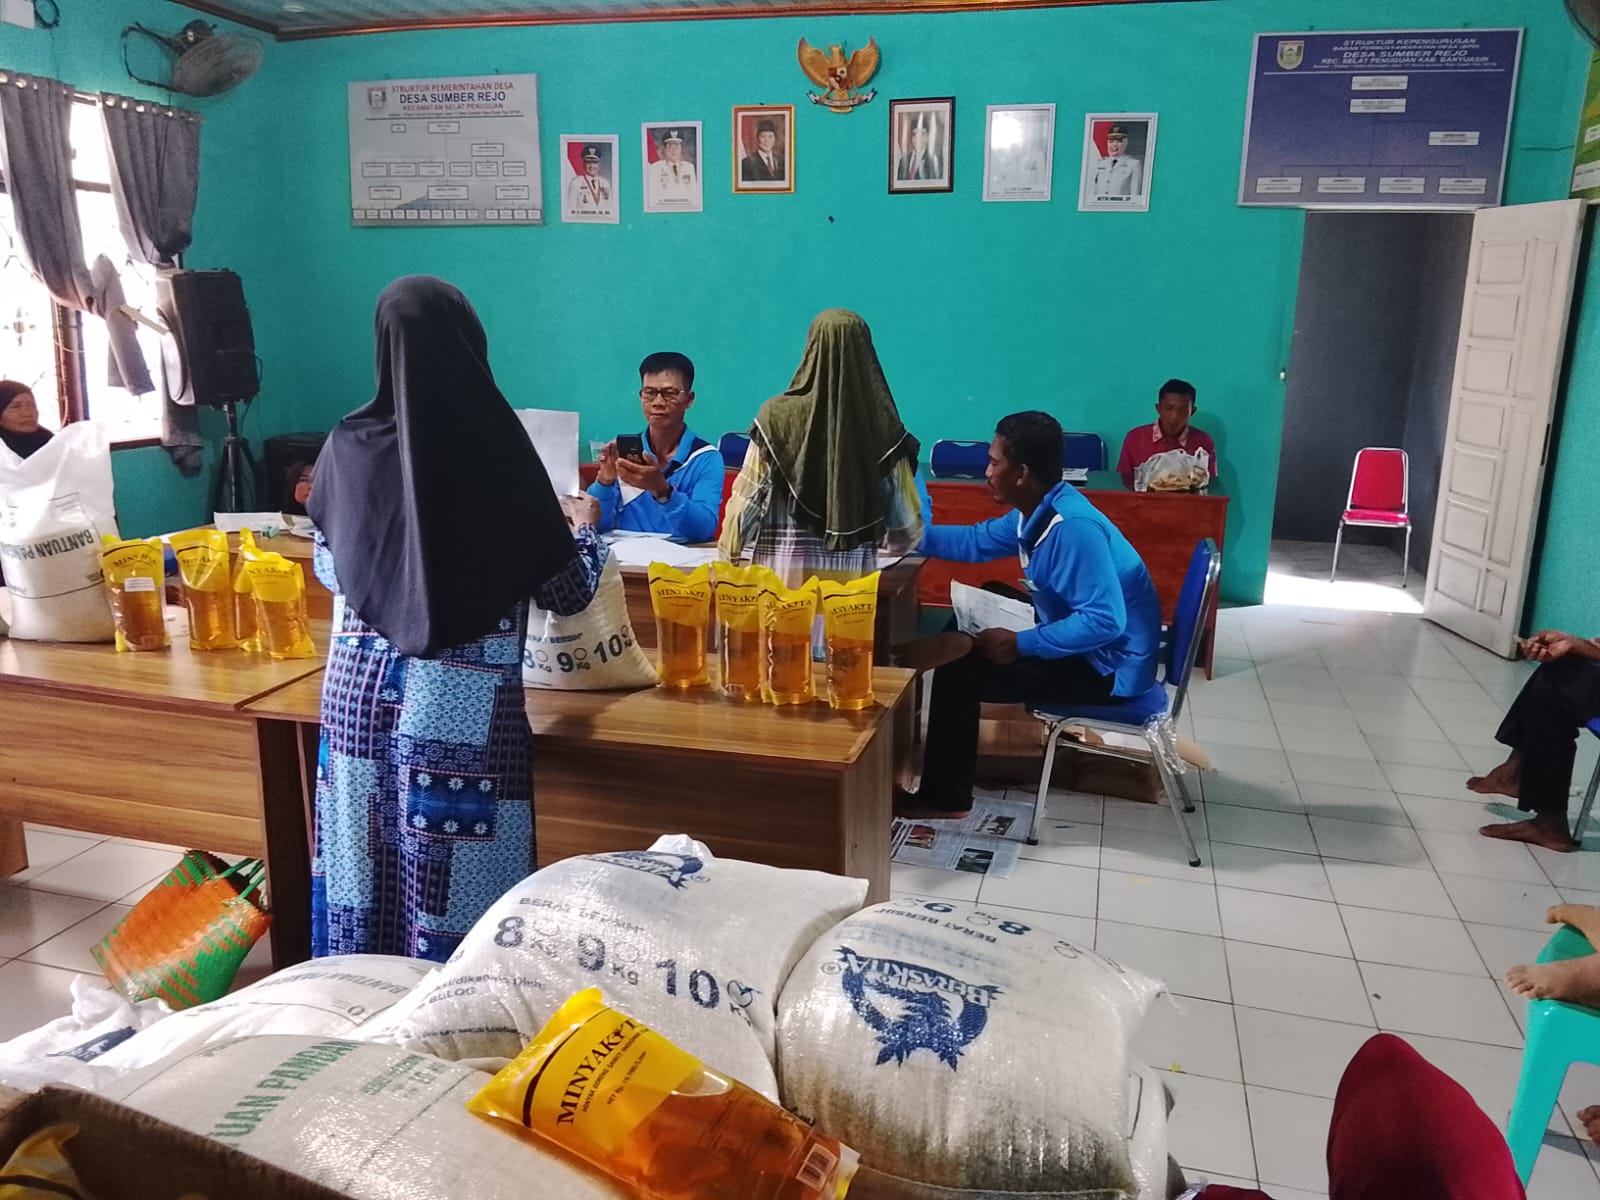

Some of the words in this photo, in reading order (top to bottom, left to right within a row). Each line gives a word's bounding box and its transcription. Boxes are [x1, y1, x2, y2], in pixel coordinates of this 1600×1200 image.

[1396, 38, 1477, 46] KEPENGURUSAN
[1379, 50, 1432, 58] SUMBER
[1434, 49, 1469, 57] REJO
[391, 84, 432, 93] STRUKTUR
[431, 82, 493, 93] PEMERINTAHAN
[493, 82, 514, 91] DESA
[399, 93, 429, 104] DESA
[430, 92, 475, 103] SUMBER
[477, 91, 506, 102] REJO
[34, 529, 94, 558] BANTUAN
[556, 652, 574, 673] 9
[594, 634, 623, 664] 10
[943, 921, 998, 944] BERAT
[998, 920, 1032, 936] 8
[494, 916, 525, 948] 8
[577, 933, 606, 972] 9
[612, 962, 640, 986] Kg
[656, 959, 720, 1010] 10
